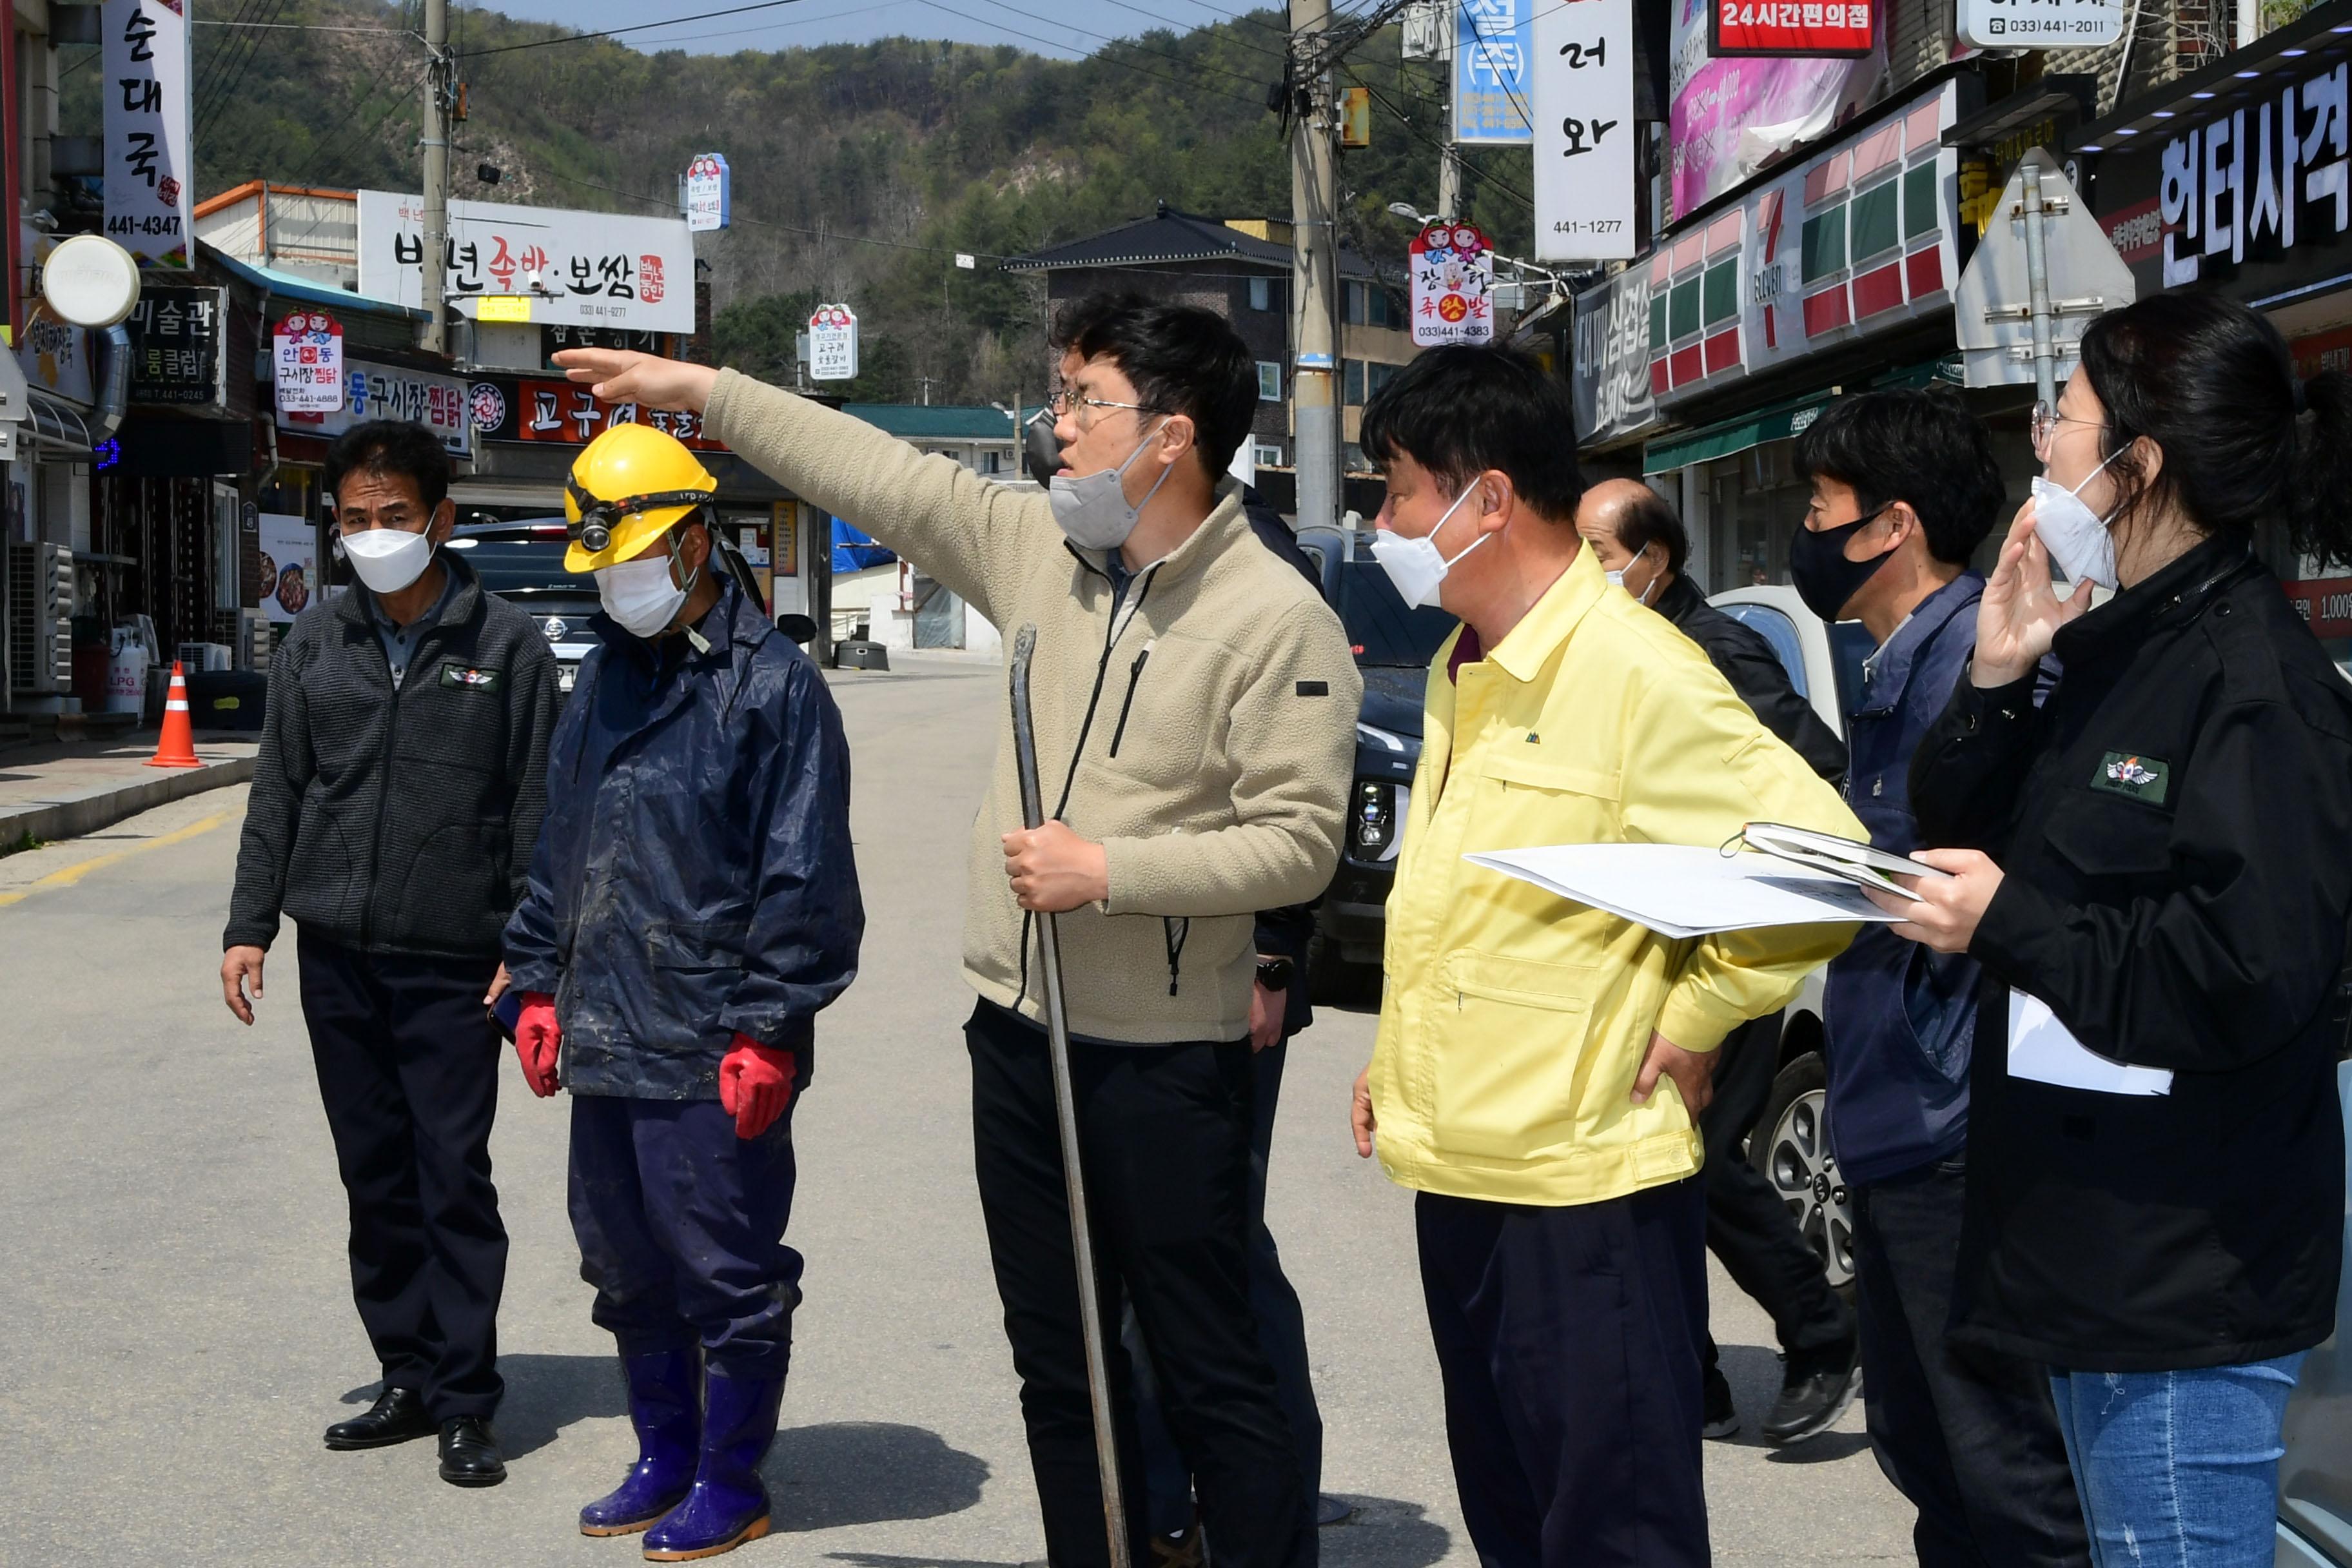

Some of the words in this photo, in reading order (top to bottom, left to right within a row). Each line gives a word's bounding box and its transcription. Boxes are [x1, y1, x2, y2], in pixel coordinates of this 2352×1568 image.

[1723, 3, 1868, 28] 24시간편의점
[2010, 19, 2104, 33] 033)441-2011
[119, 8, 161, 187] 순대국
[1559, 37, 1618, 157] 러와
[2161, 61, 2351, 289] 헌터사격
[108, 215, 181, 235] 441-4347
[1553, 220, 1622, 233] 441-1277
[130, 300, 214, 336] 미술관
[1418, 326, 1489, 337] 033)441-4383
[819, 341, 845, 353] 고구려
[279, 368, 337, 384] 구시장찜닭
[279, 395, 338, 403] 033-441-4888
[344, 373, 464, 428] 동구시장찜닭
[110, 676, 135, 687] LPG
